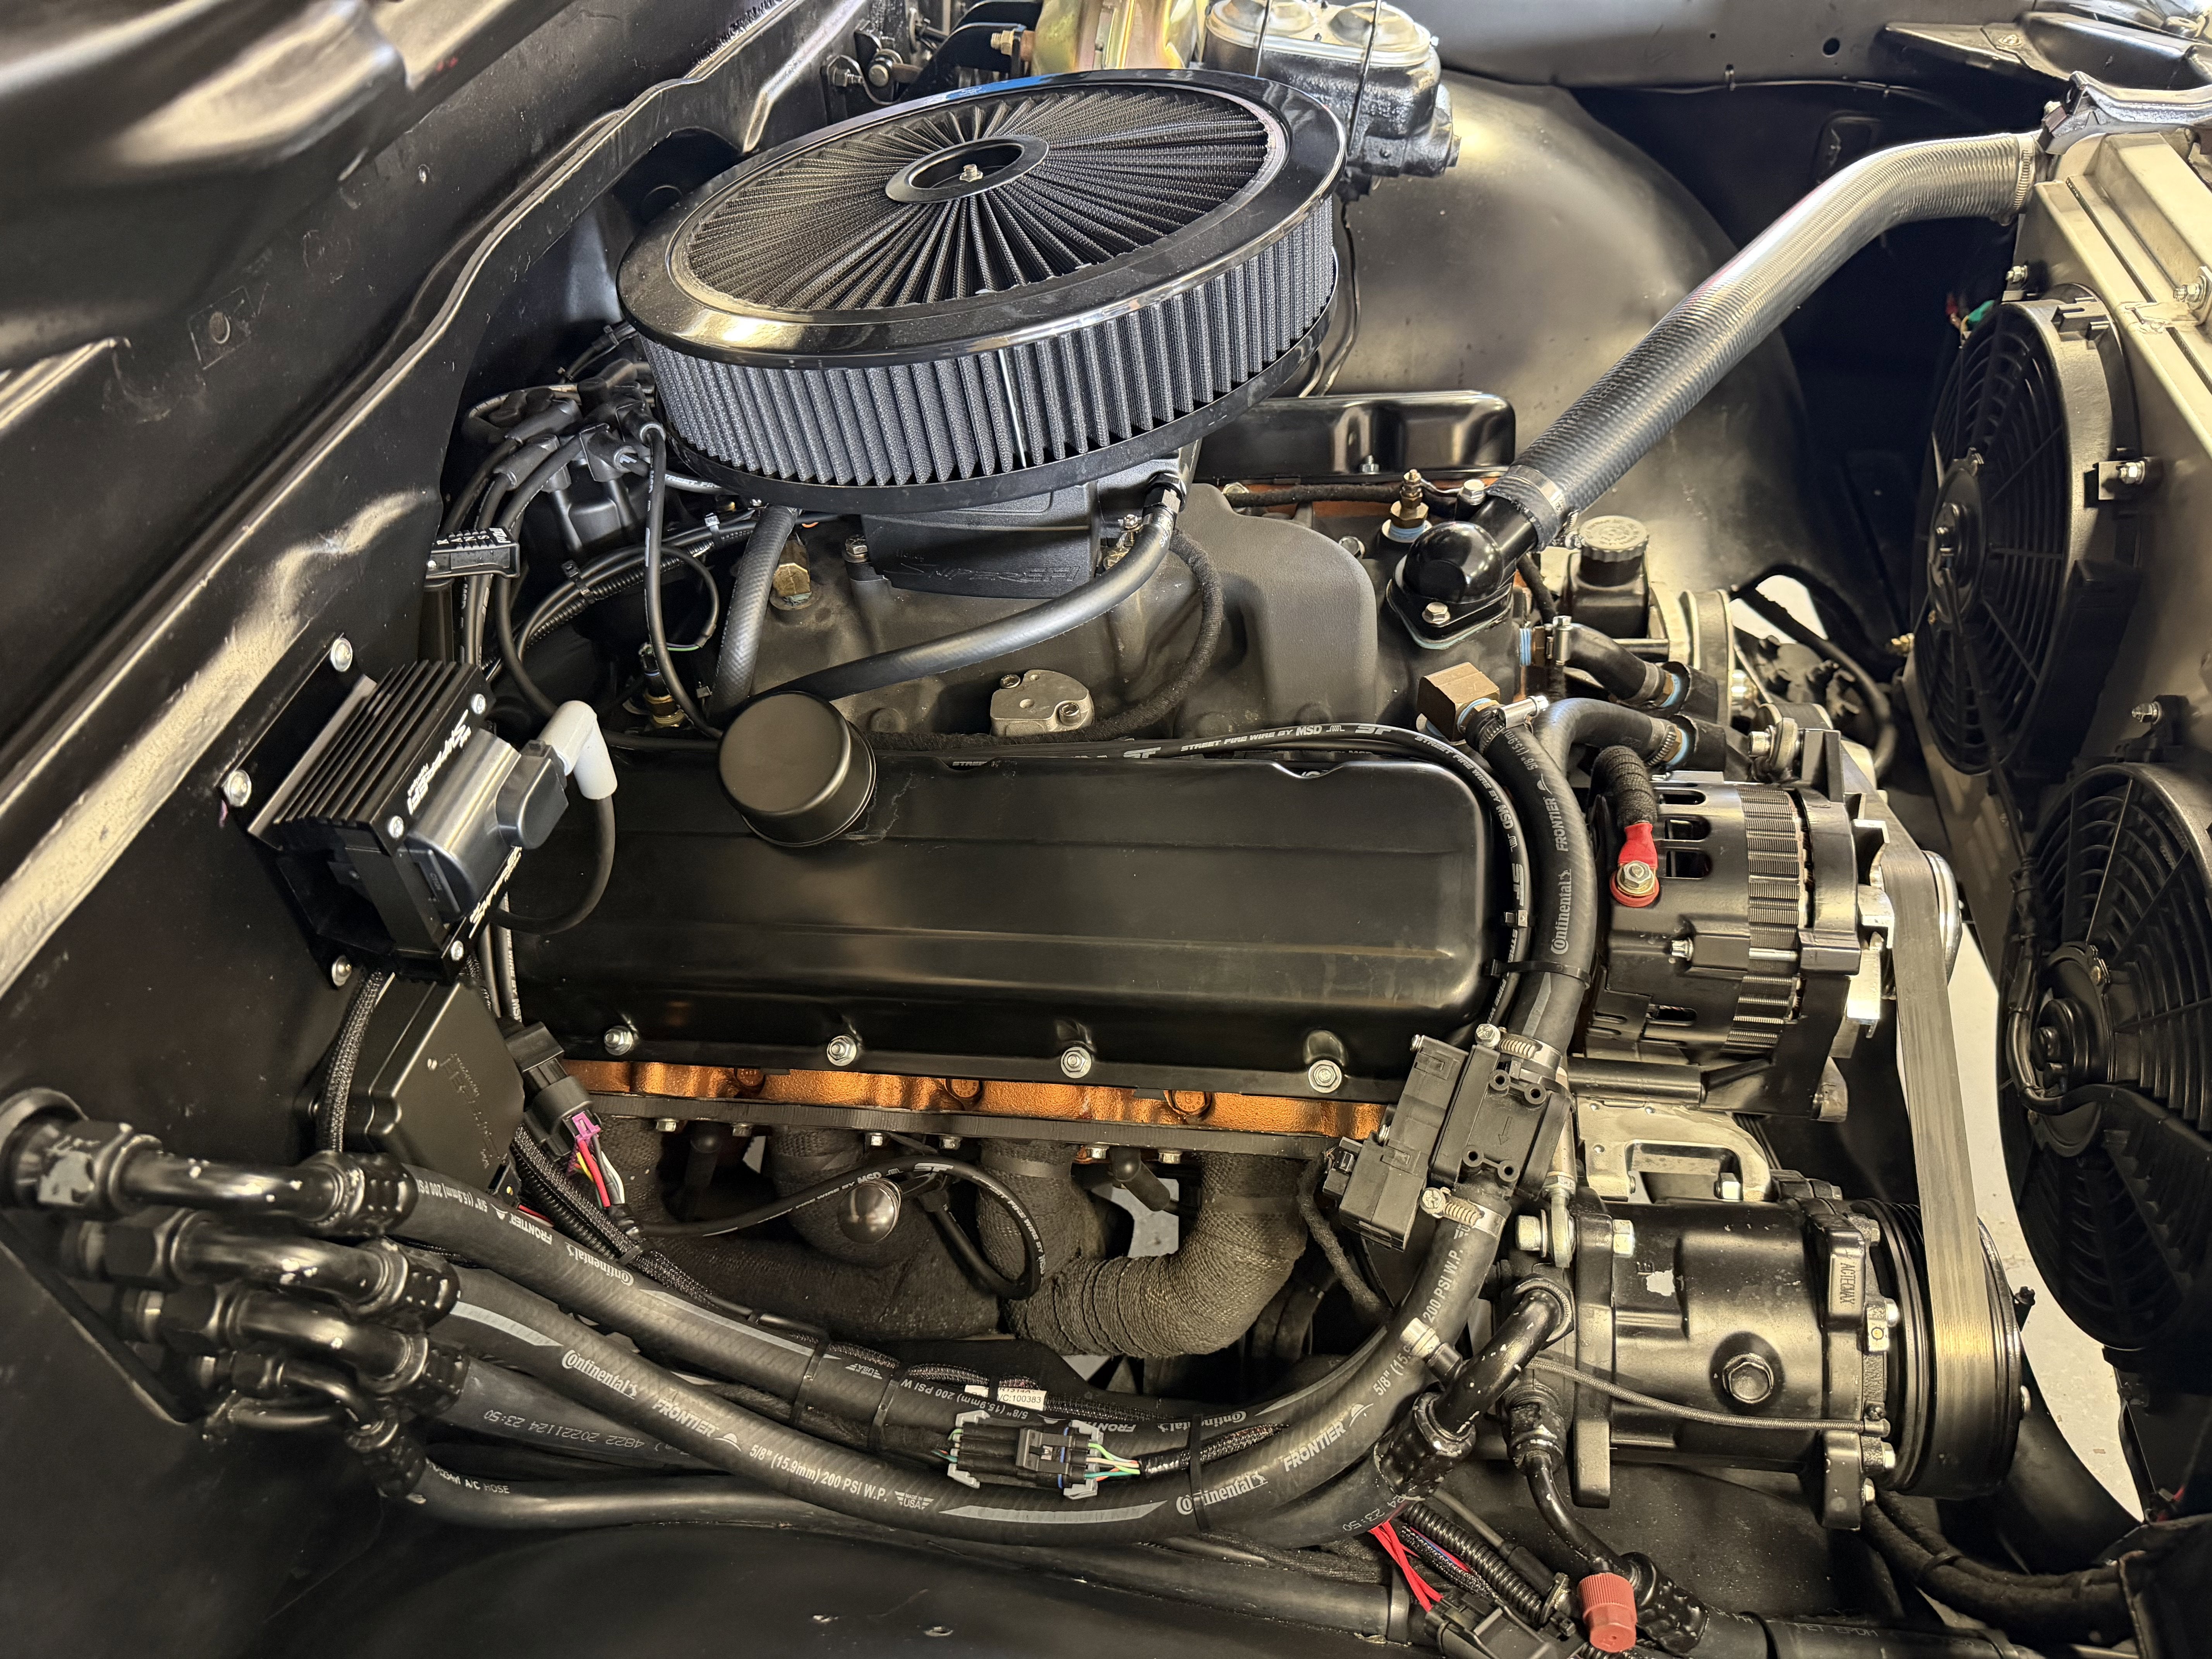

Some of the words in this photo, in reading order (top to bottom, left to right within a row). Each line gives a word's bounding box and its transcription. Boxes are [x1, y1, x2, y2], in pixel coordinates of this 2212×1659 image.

[1181, 740, 1221, 751] STREET
[1224, 736, 1248, 744] FIRE
[1250, 731, 1274, 740] WIRE
[1296, 725, 1322, 736] MSD
[1415, 736, 1453, 754] STREET
[1453, 755, 1474, 770] FIRE
[1472, 769, 1492, 789] WIRE
[1489, 790, 1501, 803] BY
[1496, 804, 1513, 830] MSD
[1543, 797, 1568, 852] FRONTIER
[1550, 869, 1571, 955] Continental
[429, 1182, 443, 1198] 200
[857, 1172, 882, 1184] MSD
[509, 1212, 552, 1245] FRONTIER
[570, 1245, 634, 1286] Continental
[1443, 1249, 1464, 1278] W.P.
[1434, 1276, 1453, 1299] PSI
[1423, 1298, 1441, 1323] 200
[562, 1349, 638, 1400] Continental
[1372, 1370, 1391, 1396] 5/8"
[914, 1383, 932, 1394] PSI
[936, 1388, 953, 1399] 200
[957, 1393, 1006, 1414] (15.9mm)
[1007, 1409, 1029, 1420] 5/8"
[484, 1410, 525, 1428] 23:50
[652, 1398, 720, 1438] FRONTIER
[528, 1420, 600, 1443] 20221124
[606, 1435, 645, 1449] 4822
[1283, 1421, 1346, 1472] FRONTIER
[749, 1444, 773, 1461] 5/8"
[771, 1453, 821, 1484] (15.9mm)
[820, 1471, 842, 1488] 200
[842, 1479, 862, 1496] PSI
[864, 1483, 887, 1501] W.P.
[465, 1479, 481, 1490] A/C
[483, 1483, 510, 1494] HOSE
[903, 1498, 921, 1510] USA
[1342, 1508, 1385, 1531] 23:50
